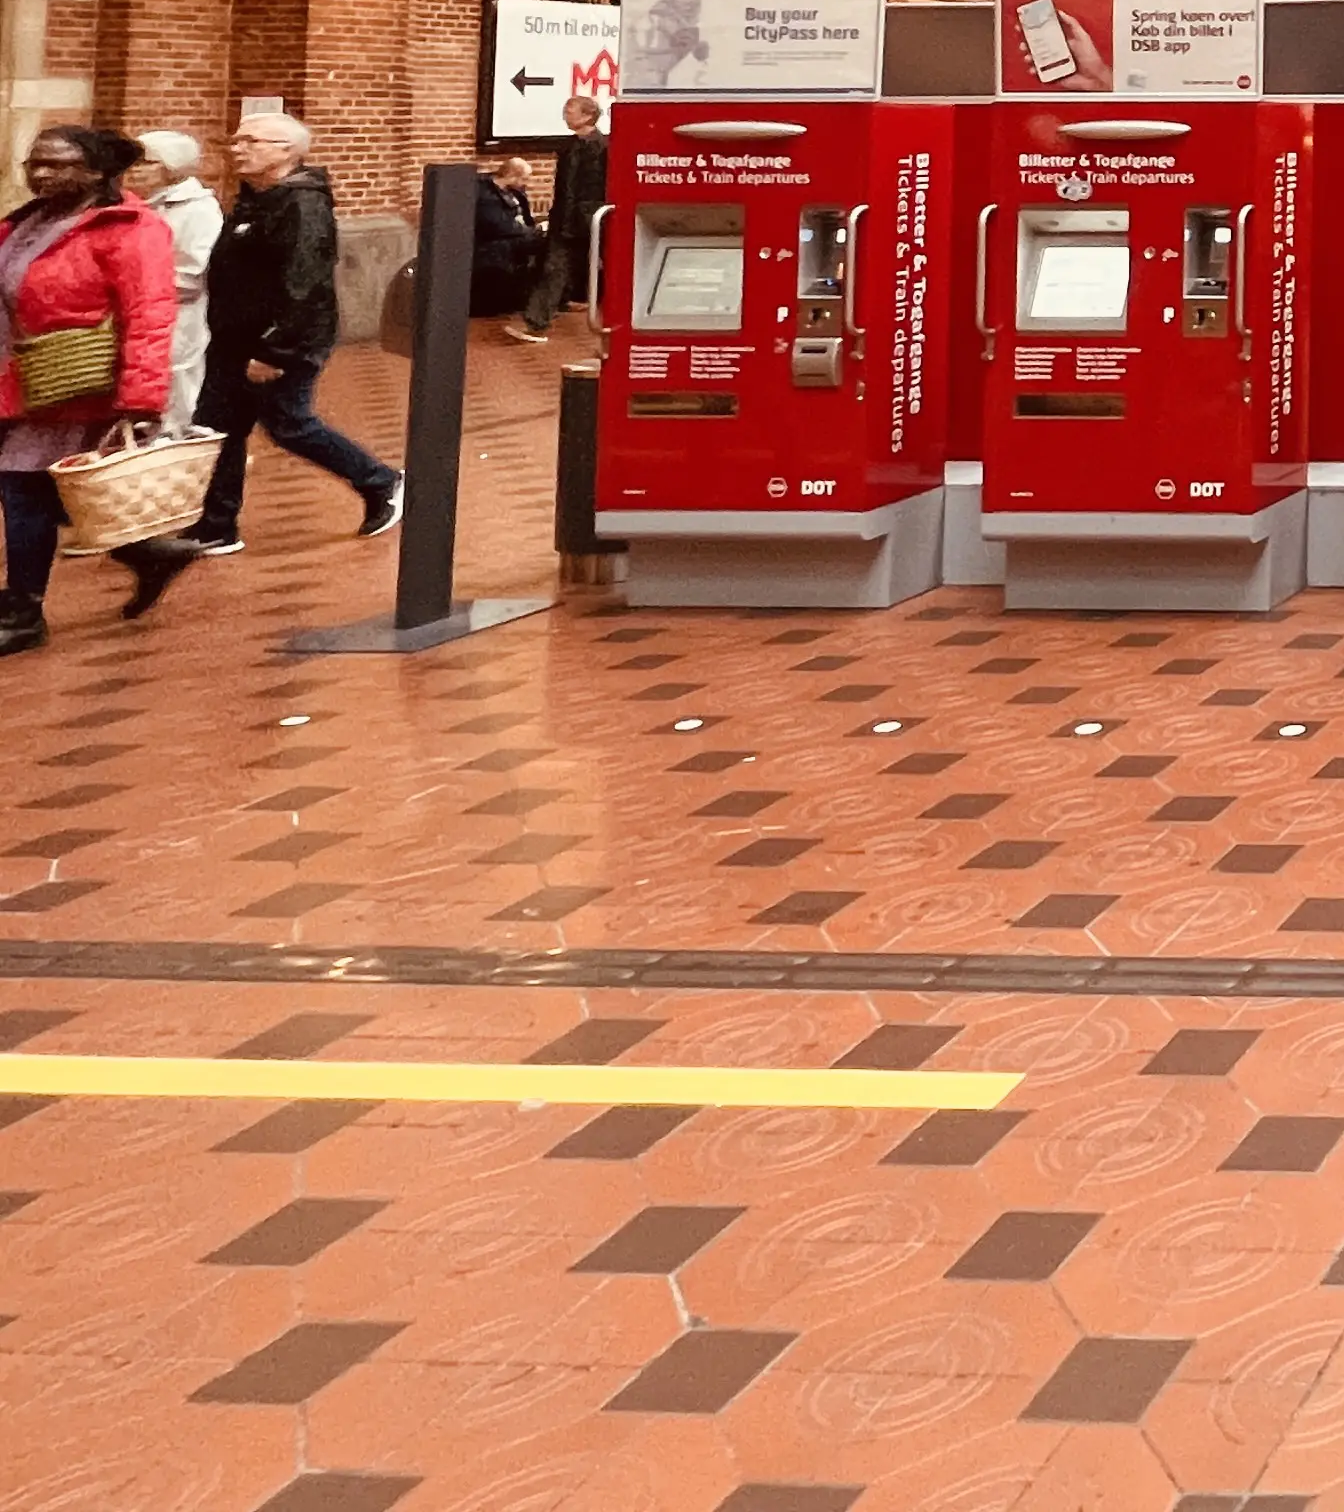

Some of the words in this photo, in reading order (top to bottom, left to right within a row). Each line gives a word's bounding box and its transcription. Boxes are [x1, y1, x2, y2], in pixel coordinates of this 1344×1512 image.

[745, 8, 776, 24] Buy
[781, 10, 818, 24] your
[1132, 10, 1177, 25] Spring
[525, 16, 543, 33] 50
[546, 22, 560, 34] m
[564, 19, 578, 35] til
[582, 23, 598, 36] en
[1131, 25, 1159, 37] Køb
[1163, 25, 1186, 37] din
[1190, 25, 1224, 37] billet
[745, 26, 817, 43] CityPass
[823, 27, 859, 39] here
[1131, 40, 1159, 52] DSB
[1165, 42, 1190, 54] app
[637, 154, 692, 167] Billetter
[696, 154, 707, 167] &
[1019, 154, 1075, 167] Billetter
[1079, 154, 1090, 166] &
[636, 171, 683, 184] Tickets
[687, 171, 696, 183] &
[701, 171, 733, 183] Train
[738, 171, 810, 185] departures
[1019, 171, 1067, 184] Tickets
[1086, 171, 1117, 184] Train
[1121, 171, 1194, 185] departures
[897, 155, 913, 234] Tickets
[914, 154, 929, 247] Billetter
[897, 242, 910, 258] &
[914, 255, 927, 272] &
[895, 266, 909, 321] Train
[891, 329, 907, 452] departures
[801, 481, 836, 495] DOT
[1190, 482, 1224, 496] DOT
